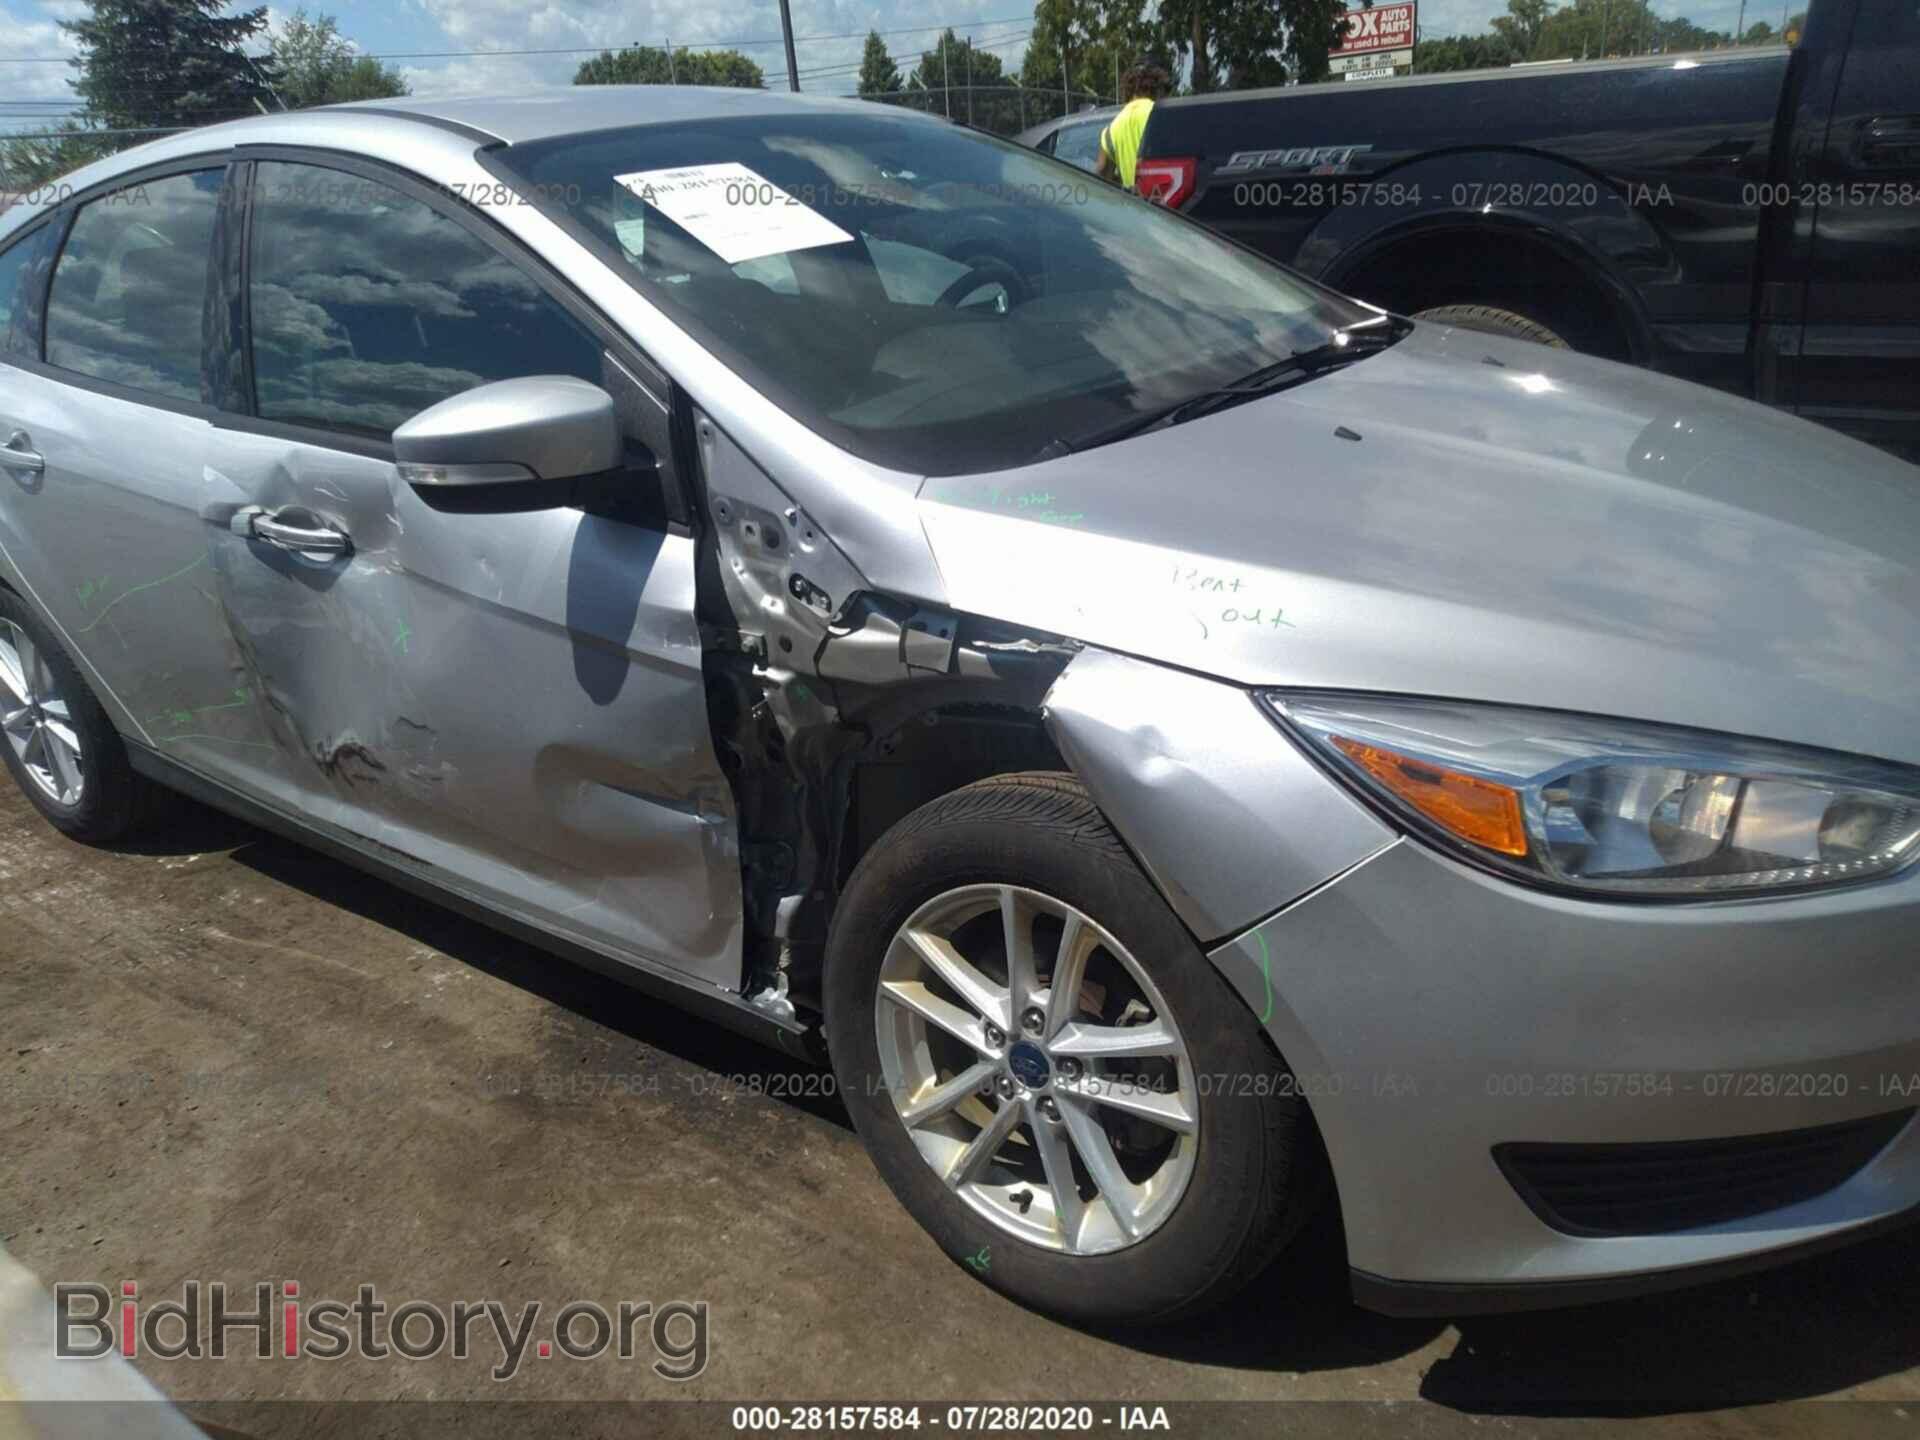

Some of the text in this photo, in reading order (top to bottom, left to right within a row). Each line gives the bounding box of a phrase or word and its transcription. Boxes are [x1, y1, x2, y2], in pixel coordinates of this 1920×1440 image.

[1381, 7, 1408, 21] AUTO
[1380, 19, 1410, 34] PARTS
[1213, 144, 1373, 175] SPORT
